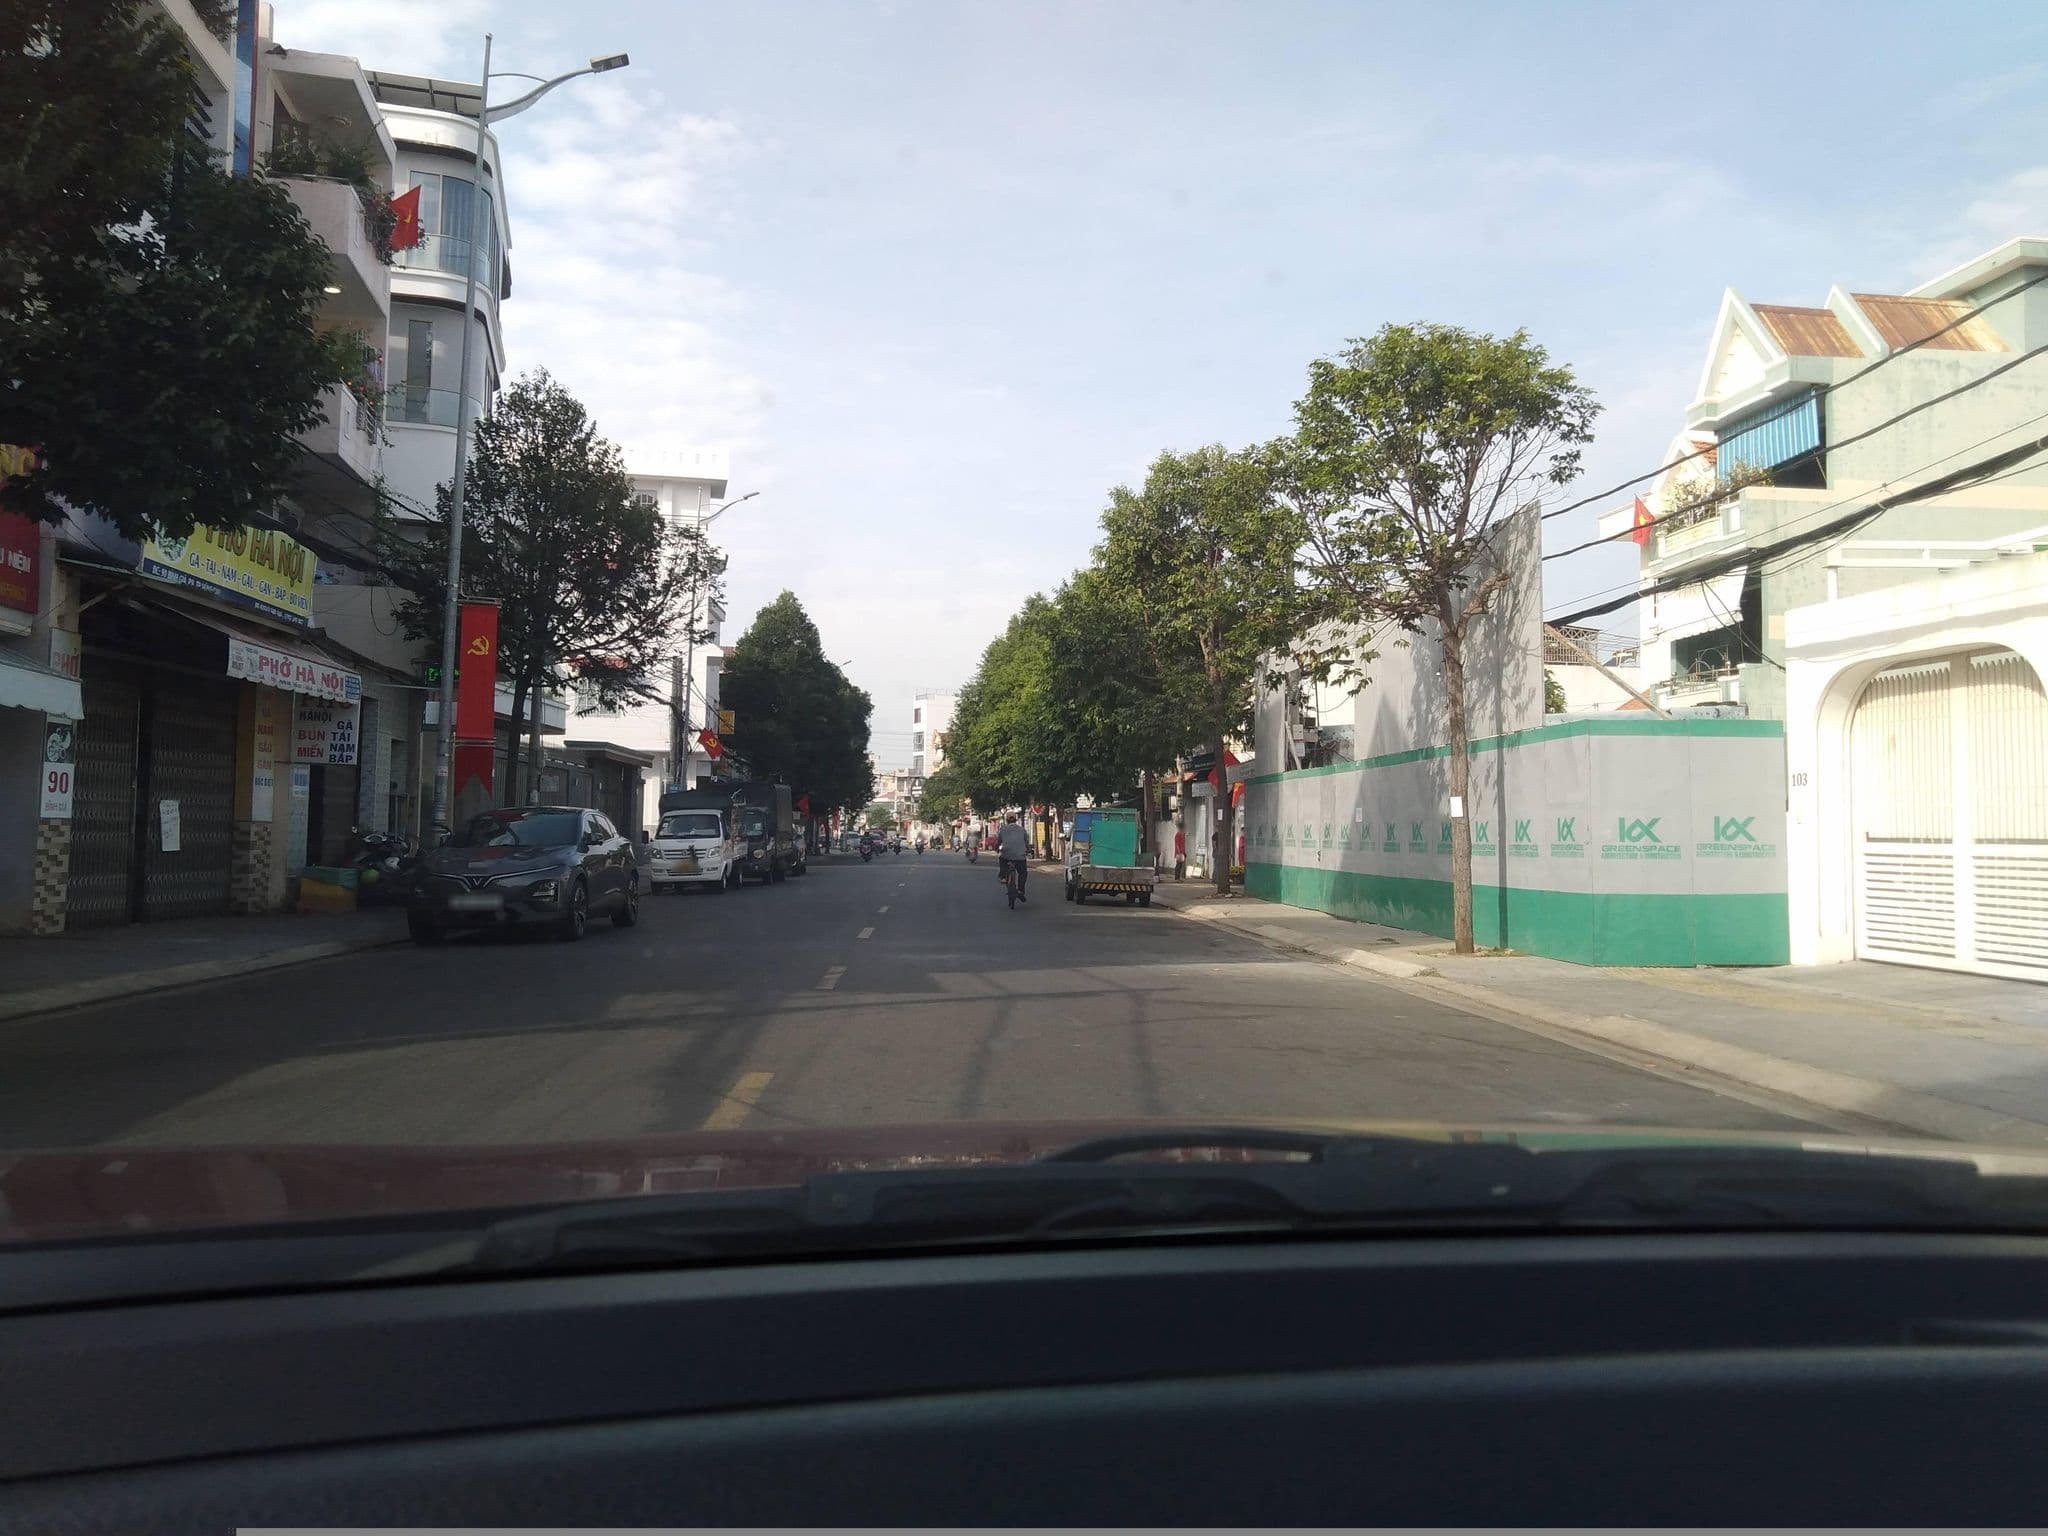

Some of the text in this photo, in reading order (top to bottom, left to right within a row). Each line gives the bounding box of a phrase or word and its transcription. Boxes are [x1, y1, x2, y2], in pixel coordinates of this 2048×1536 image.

[258, 655, 292, 678] PHỞ
[296, 665, 315, 685] HÀ
[321, 672, 344, 692] NỘI
[47, 771, 69, 794] 90
[1791, 772, 1808, 787] 103
[1601, 844, 1681, 852] GREENSPACE
